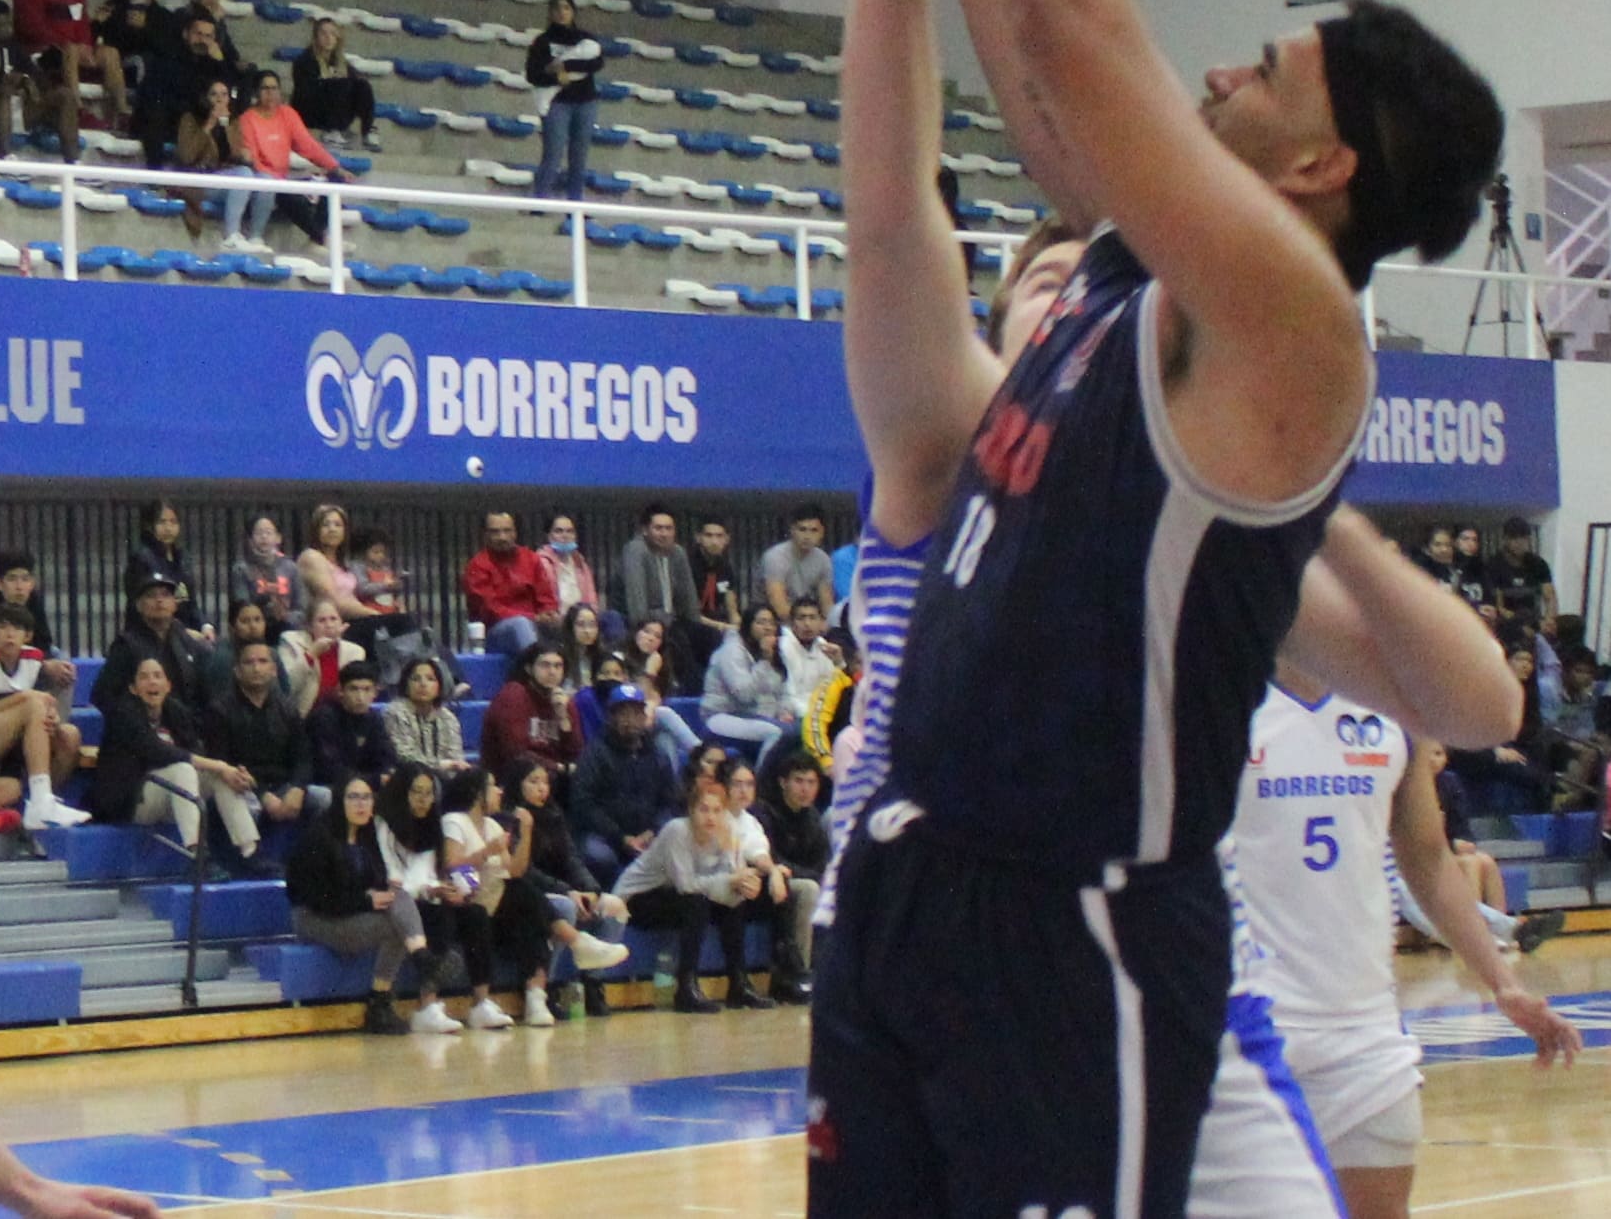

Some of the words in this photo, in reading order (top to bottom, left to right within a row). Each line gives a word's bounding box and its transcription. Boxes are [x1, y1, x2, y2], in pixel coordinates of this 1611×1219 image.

[427, 355, 698, 443] BORREGOS
[1257, 775, 1375, 799] BORREGOS
[1303, 816, 1341, 872] 5
